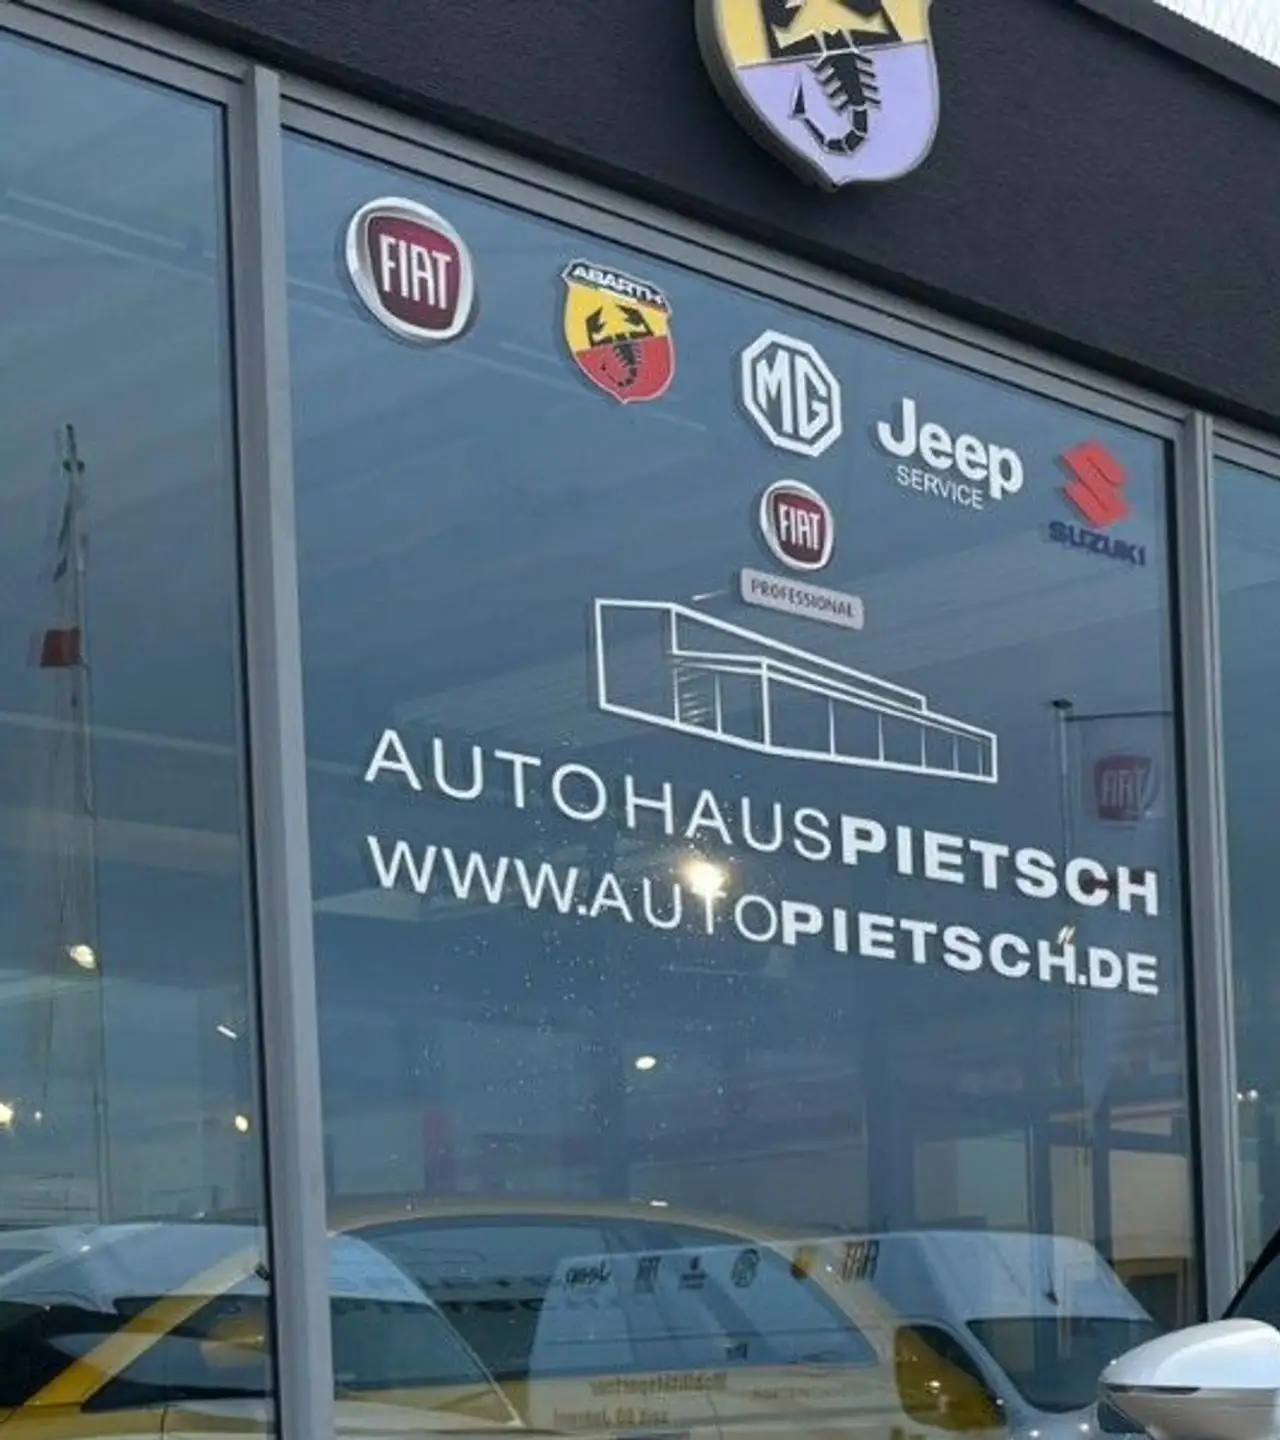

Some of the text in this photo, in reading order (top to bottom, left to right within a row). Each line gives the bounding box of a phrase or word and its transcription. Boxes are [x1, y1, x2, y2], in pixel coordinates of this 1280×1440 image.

[380, 234, 452, 310] FIAT
[573, 264, 666, 305] ABARTH
[754, 346, 830, 440] MG
[877, 398, 1024, 499] Jeep
[896, 464, 984, 510] SERVICE
[778, 508, 822, 551] FIAT
[1048, 520, 1147, 566] SUZUKI
[750, 577, 856, 619] PROFESSIONAL
[364, 728, 1160, 916] AUTOHAUSPIETSCH
[366, 835, 1160, 996] WWW.AUTOPIETSCH.DE
